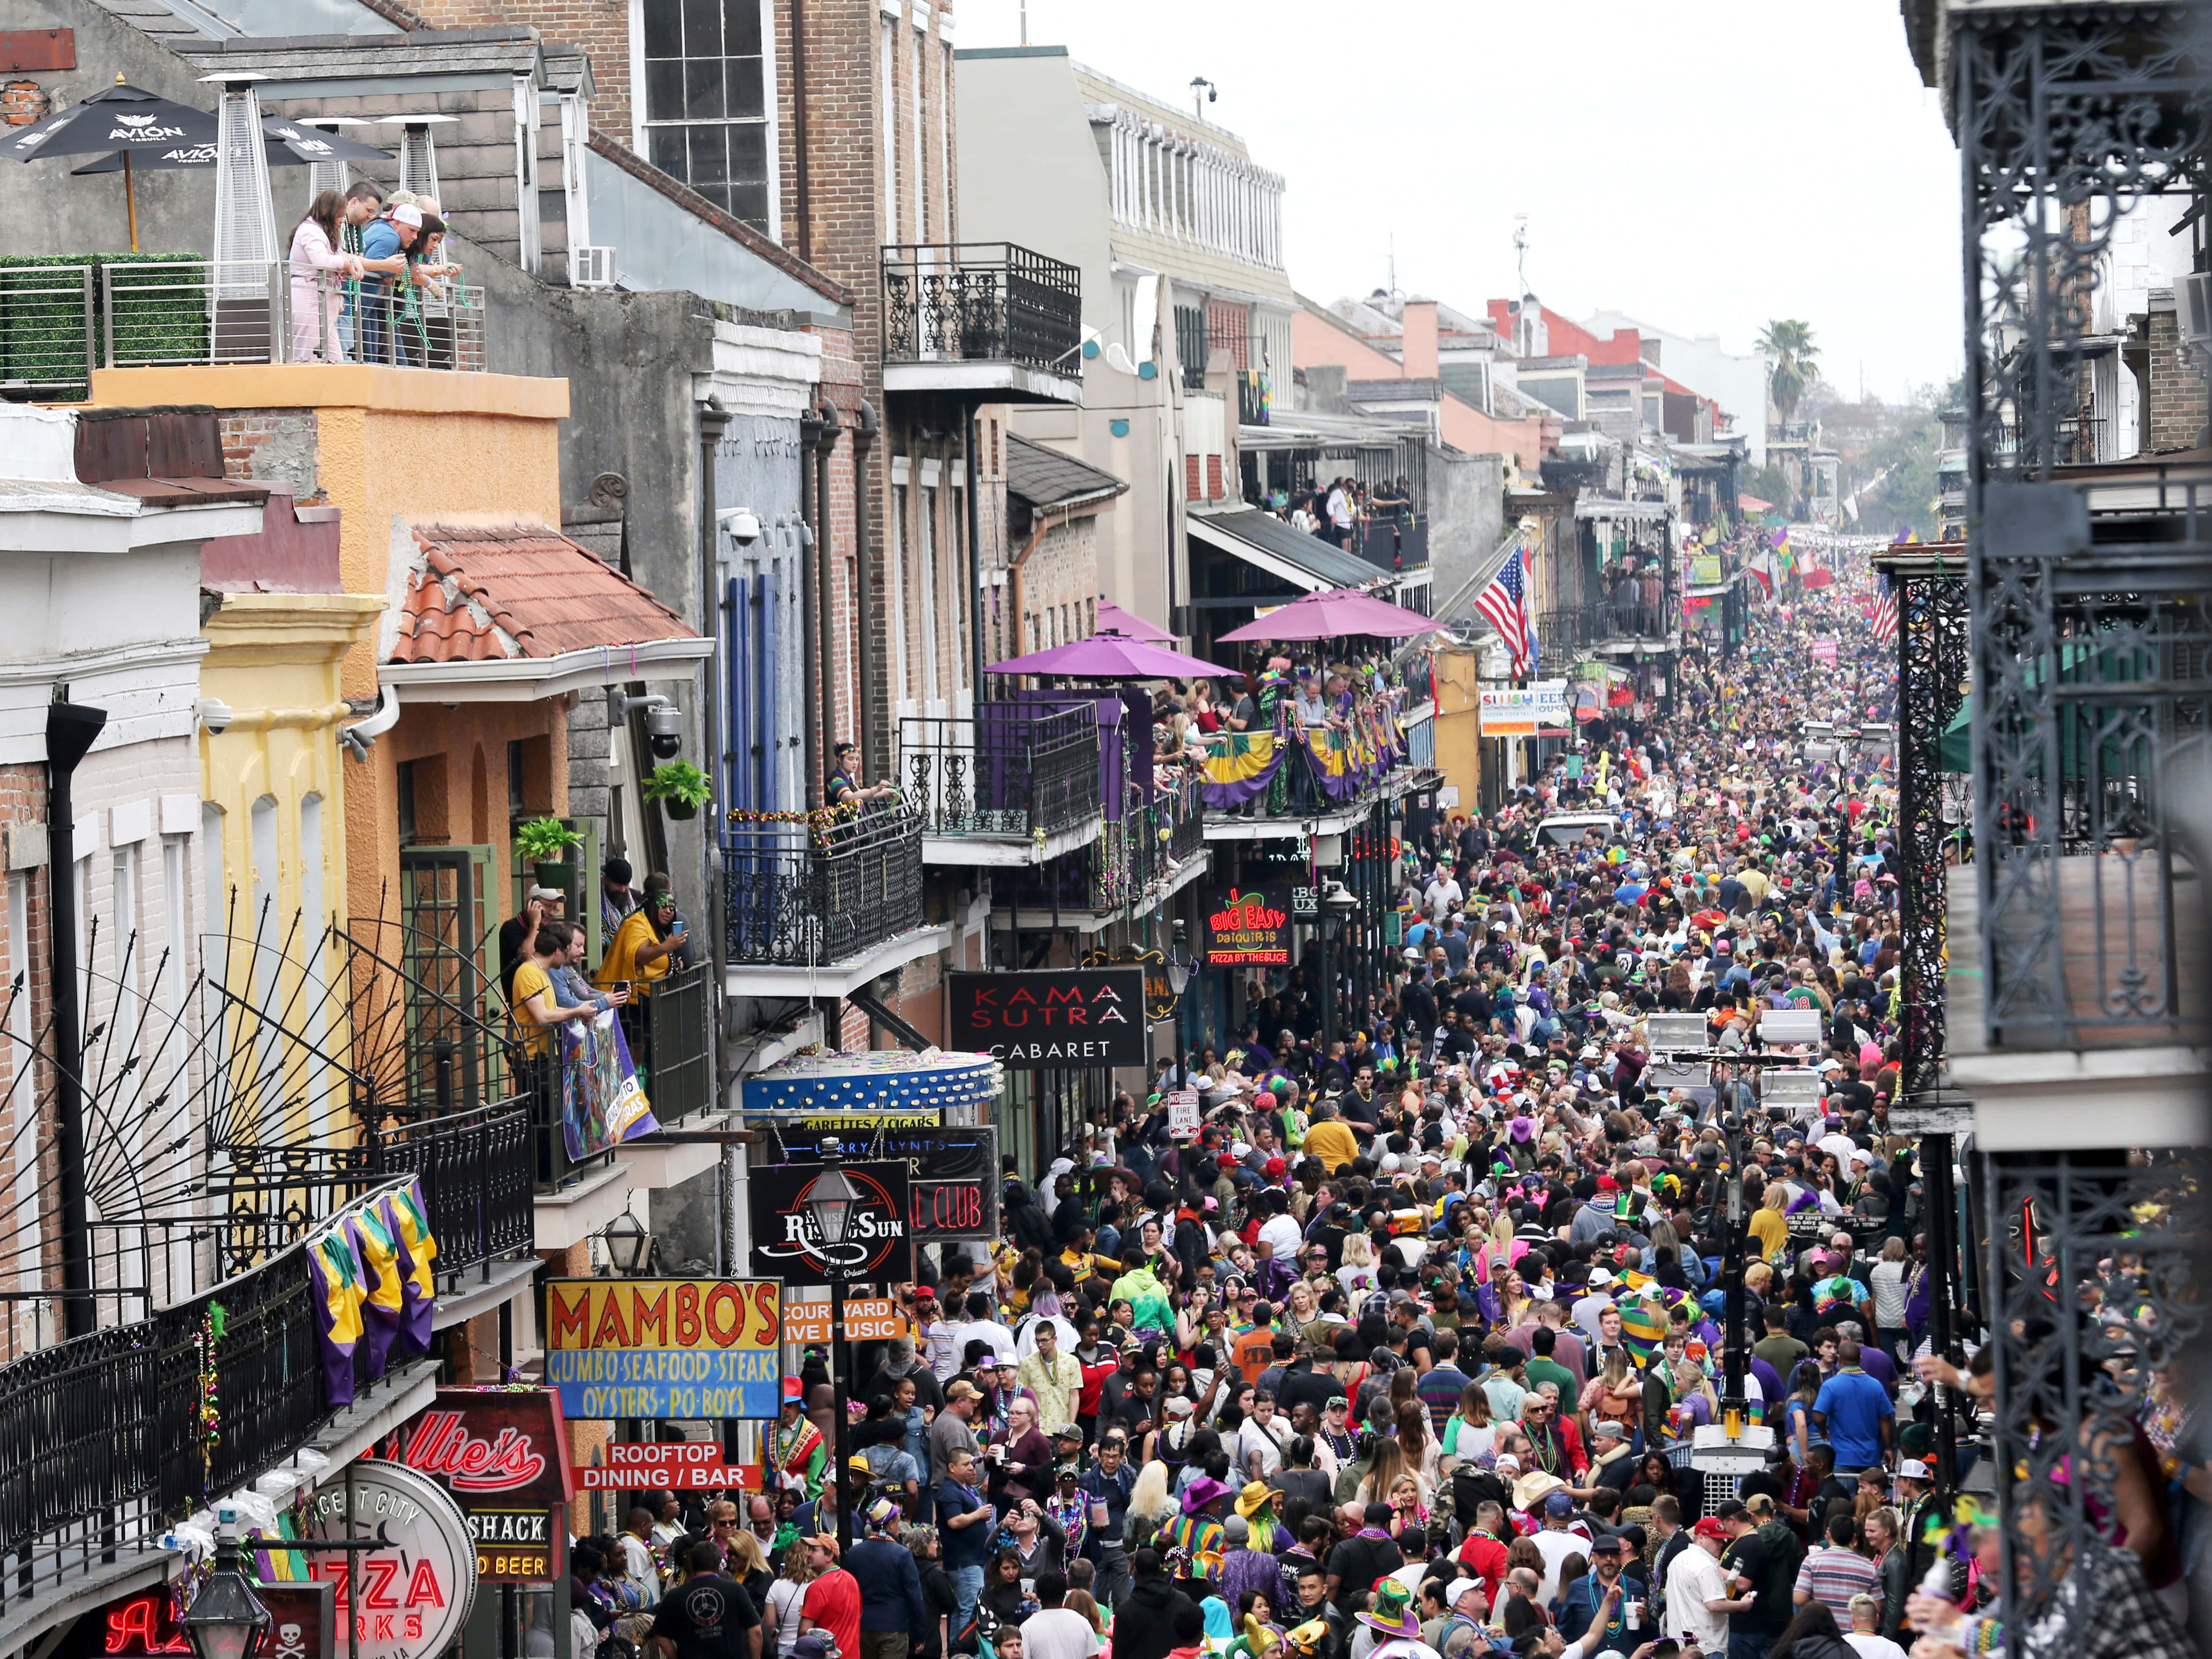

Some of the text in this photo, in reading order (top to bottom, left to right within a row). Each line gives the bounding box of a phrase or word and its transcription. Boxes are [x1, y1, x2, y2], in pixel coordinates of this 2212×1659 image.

[161, 147, 218, 160] AVIÓ
[1483, 694, 1533, 709] SLUSH
[1210, 905, 1286, 931] BIG EASY
[1210, 953, 1234, 963] PIZZA
[1235, 953, 1246, 962] BY
[975, 985, 1122, 1006] KAMA
[1794, 997, 1810, 1010] 18
[971, 1006, 1127, 1028] SUTRA
[989, 1041, 1110, 1060] CABARET
[1170, 1094, 1179, 1103] NO
[887, 1118, 934, 1129] CIGARS
[1175, 1116, 1193, 1125] LANE
[815, 1142, 868, 1153] LRRY
[934, 1186, 981, 1227] CLUB
[858, 1212, 903, 1238] SUN
[551, 1281, 779, 1350] MAMBO'S
[548, 1351, 779, 1383] GUMBO SEAFOOD STEAKS
[582, 1386, 657, 1418] OYSTERS
[612, 1445, 717, 1463] ROOFTOP
[584, 1468, 745, 1487] DINING / BAR
[376, 1493, 421, 1525] CITY
[468, 1515, 546, 1541] SHACK
[495, 1556, 546, 1575] BEER
